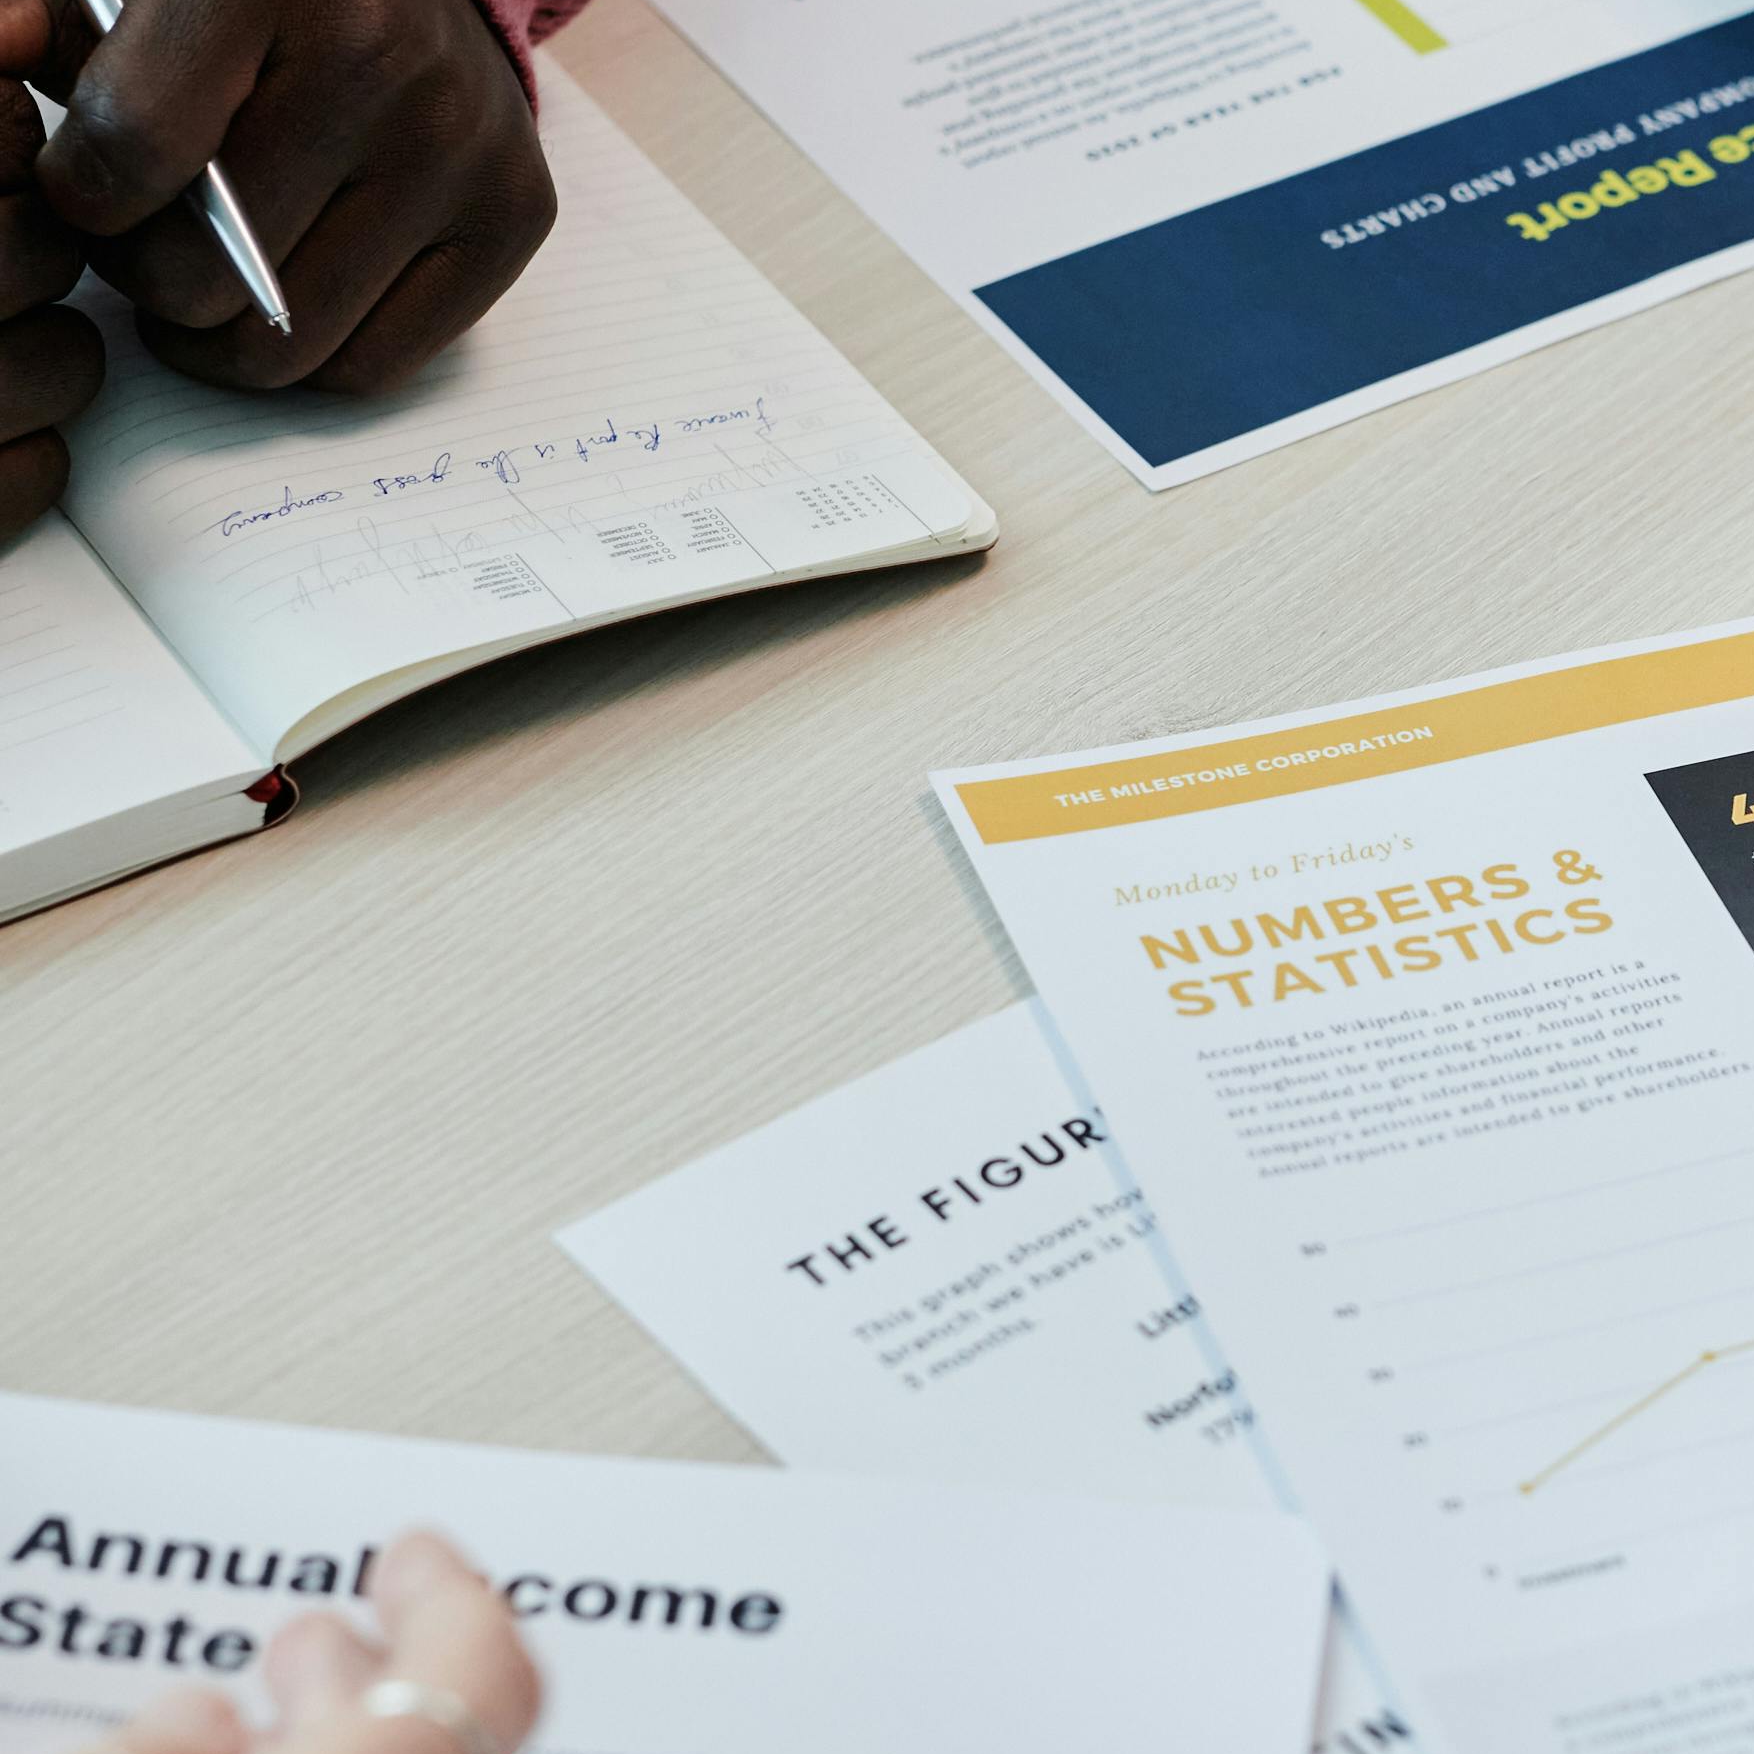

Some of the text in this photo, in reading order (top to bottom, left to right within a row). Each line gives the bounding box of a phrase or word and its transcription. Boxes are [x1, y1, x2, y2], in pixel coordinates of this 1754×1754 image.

[1449, 166, 1515, 202] AND
[1505, 149, 1716, 241] Report
[1522, 123, 1635, 178] PROFIT
[1320, 193, 1446, 249] CHARTS
[1053, 725, 1433, 807] THE MILESTONE CORPORATION
[1113, 833, 1413, 906] Monday to Friday's
[1139, 849, 1602, 969] NUMBERS &
[1167, 897, 1613, 1016] STATISTICS
[1196, 960, 1644, 1061] According to Wikipedia, an annual report is a
[1205, 973, 1680, 1080] comprehensive report on a company's activities
[787, 1110, 1105, 1284] THE FIGUR
[853, 1307, 915, 1342] This
[920, 1263, 1002, 1313] graph
[1005, 1216, 1091, 1266] shows
[985, 1287, 1023, 1312] we
[1028, 1250, 1094, 1287] have
[1098, 1234, 1125, 1252] is
[9, 1513, 381, 1600] Annual
